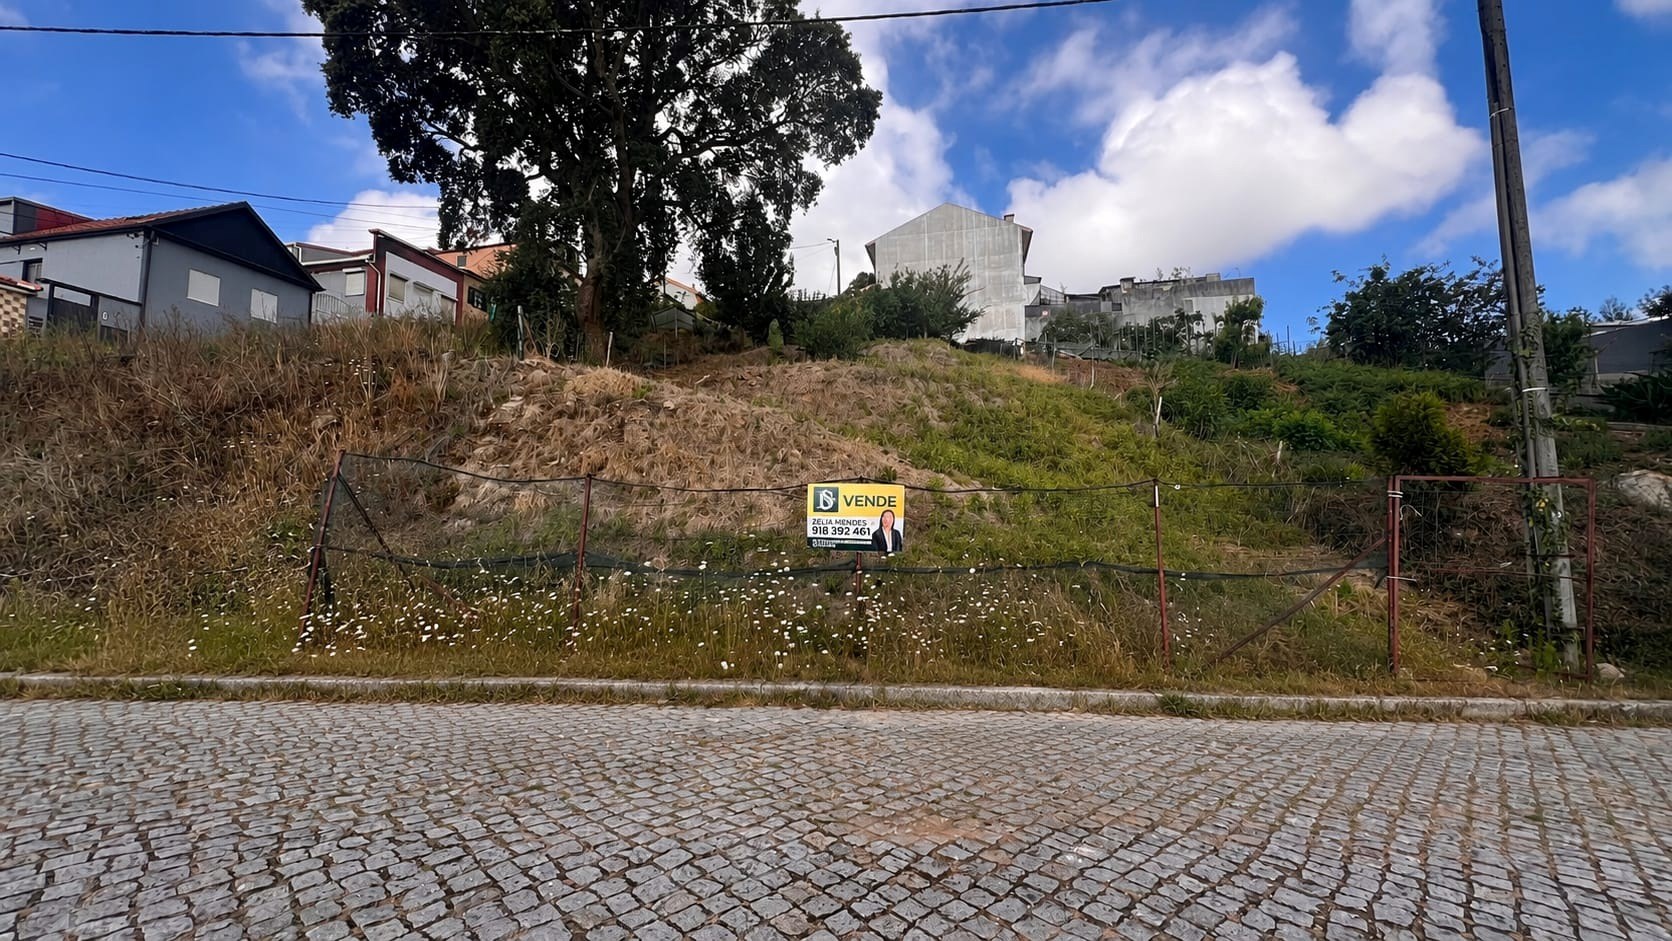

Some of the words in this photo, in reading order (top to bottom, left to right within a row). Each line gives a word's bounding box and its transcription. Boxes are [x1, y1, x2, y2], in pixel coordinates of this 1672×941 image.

[843, 495, 897, 508] VENDE
[812, 526, 829, 535] 918
[831, 527, 850, 536] 392
[852, 527, 871, 536] 461
